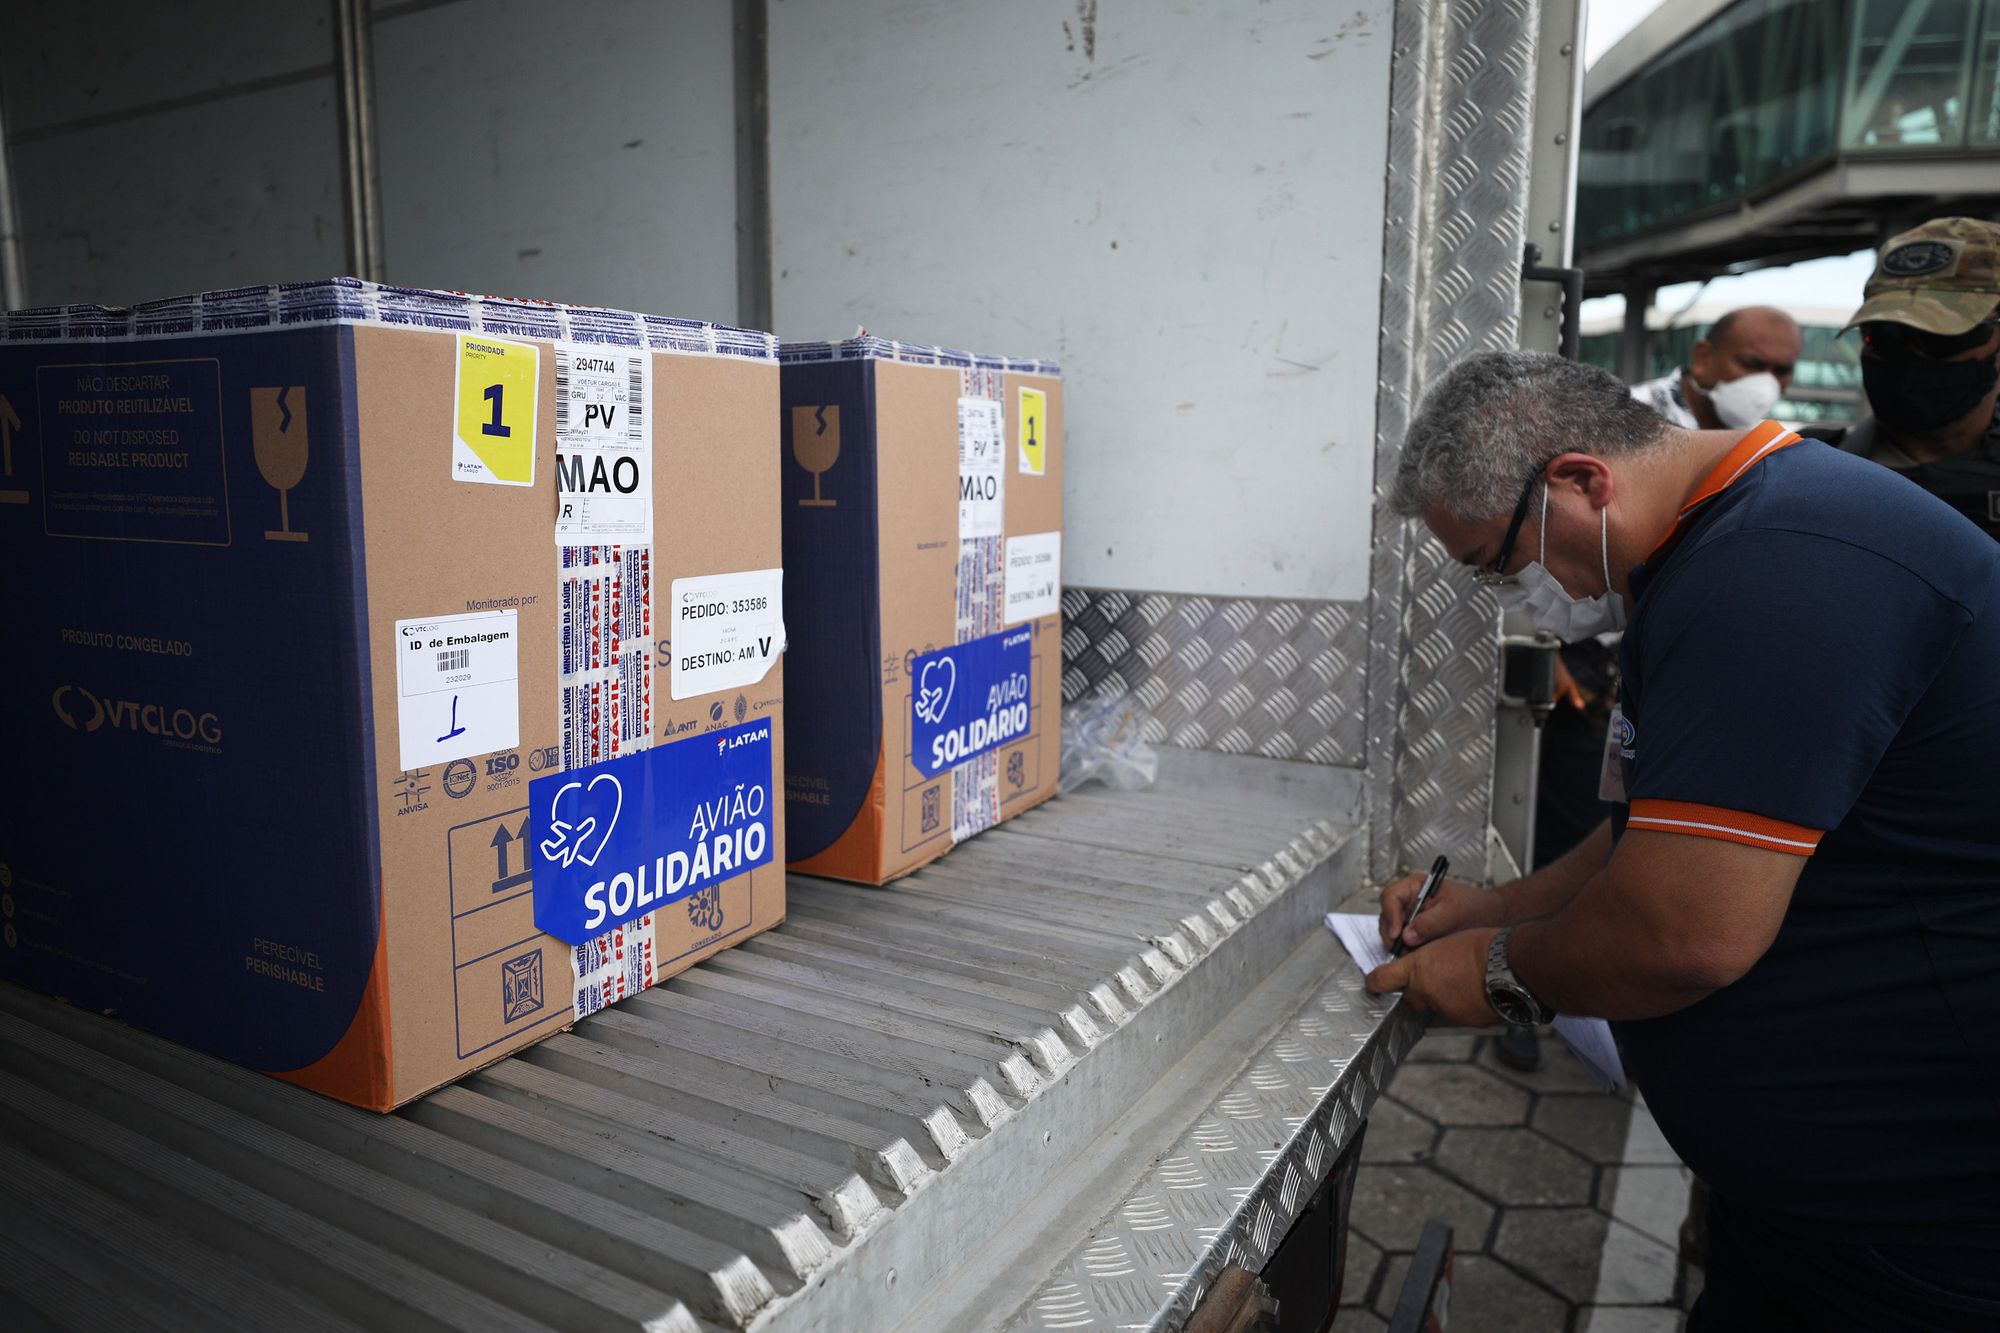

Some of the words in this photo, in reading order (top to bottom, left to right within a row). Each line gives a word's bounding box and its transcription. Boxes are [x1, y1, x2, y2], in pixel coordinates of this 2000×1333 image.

[380, 311, 409, 325] SAÚDE
[411, 315, 424, 326] DA
[425, 316, 471, 330] MINISTÉRIO
[483, 321, 508, 335] SAÚDE
[510, 325, 521, 336] DA
[571, 331, 595, 343] SAÚDE
[596, 334, 605, 343] DA
[466, 342, 505, 356] PRIORIDADE
[466, 352, 486, 360] PRIORITY
[576, 357, 615, 374] 2947744
[77, 374, 102, 392] NÃO
[106, 374, 170, 392] DESCARTAR
[571, 390, 586, 400] GRU
[58, 400, 114, 415] PRODUTO
[116, 396, 195, 414] REUTILIZÁVEL
[482, 384, 511, 438] 1
[585, 404, 615, 430] PV
[74, 431, 91, 445] DO
[93, 430, 119, 445] NOT
[120, 430, 179, 446] DISPOSED
[1028, 416, 1037, 446] 1
[974, 440, 987, 456] PV
[68, 452, 130, 468] REUSABLE
[132, 453, 189, 469] PRODUCT
[555, 454, 639, 494] MAO
[960, 475, 996, 501] MAO
[562, 504, 573, 518] R
[562, 581, 571, 610] SAÚDE
[641, 549, 650, 635] FRÁGIL
[1046, 581, 1054, 597] V
[466, 596, 519, 611] Monitorado
[522, 595, 539, 606] por:
[682, 603, 729, 620] PEDIDO:
[732, 597, 767, 613] 353586
[564, 611, 571, 624] DA
[590, 579, 599, 668] FRÁGIL
[610, 575, 620, 665] FRÁGIL
[415, 625, 440, 633] VTCLOG
[62, 628, 113, 649] PRODUTO
[116, 635, 193, 657] CONGELADO
[410, 641, 422, 650] ID
[429, 639, 443, 648] de
[446, 631, 510, 646] Embalagem
[562, 625, 571, 674] MINISTÉRIO
[681, 650, 736, 671] DESTINO:
[738, 646, 755, 660] AM
[758, 636, 772, 657] V
[445, 674, 472, 684] 232029
[562, 686, 571, 710] SAÚDE
[986, 672, 1027, 711] AVIÃO
[103, 698, 222, 744] VTCLOG
[563, 711, 571, 723] DA
[677, 720, 697, 734] ANTT
[704, 721, 728, 733] ANAC
[931, 701, 1028, 770] SOLIDÁRIO
[563, 725, 571, 771] INISTÉRIO
[728, 728, 768, 749] LATAM
[486, 754, 520, 776] ISO
[486, 777, 521, 792] 9001:2015
[397, 803, 429, 816] ANVISA
[689, 784, 764, 839] AVIÃO
[584, 822, 766, 930] SOLIDÁRIO
[253, 936, 323, 971] PERECÍVEL
[599, 935, 608, 967] FR
[245, 955, 324, 992] PERISHABLE
[576, 988, 586, 1015] SAÚDE
